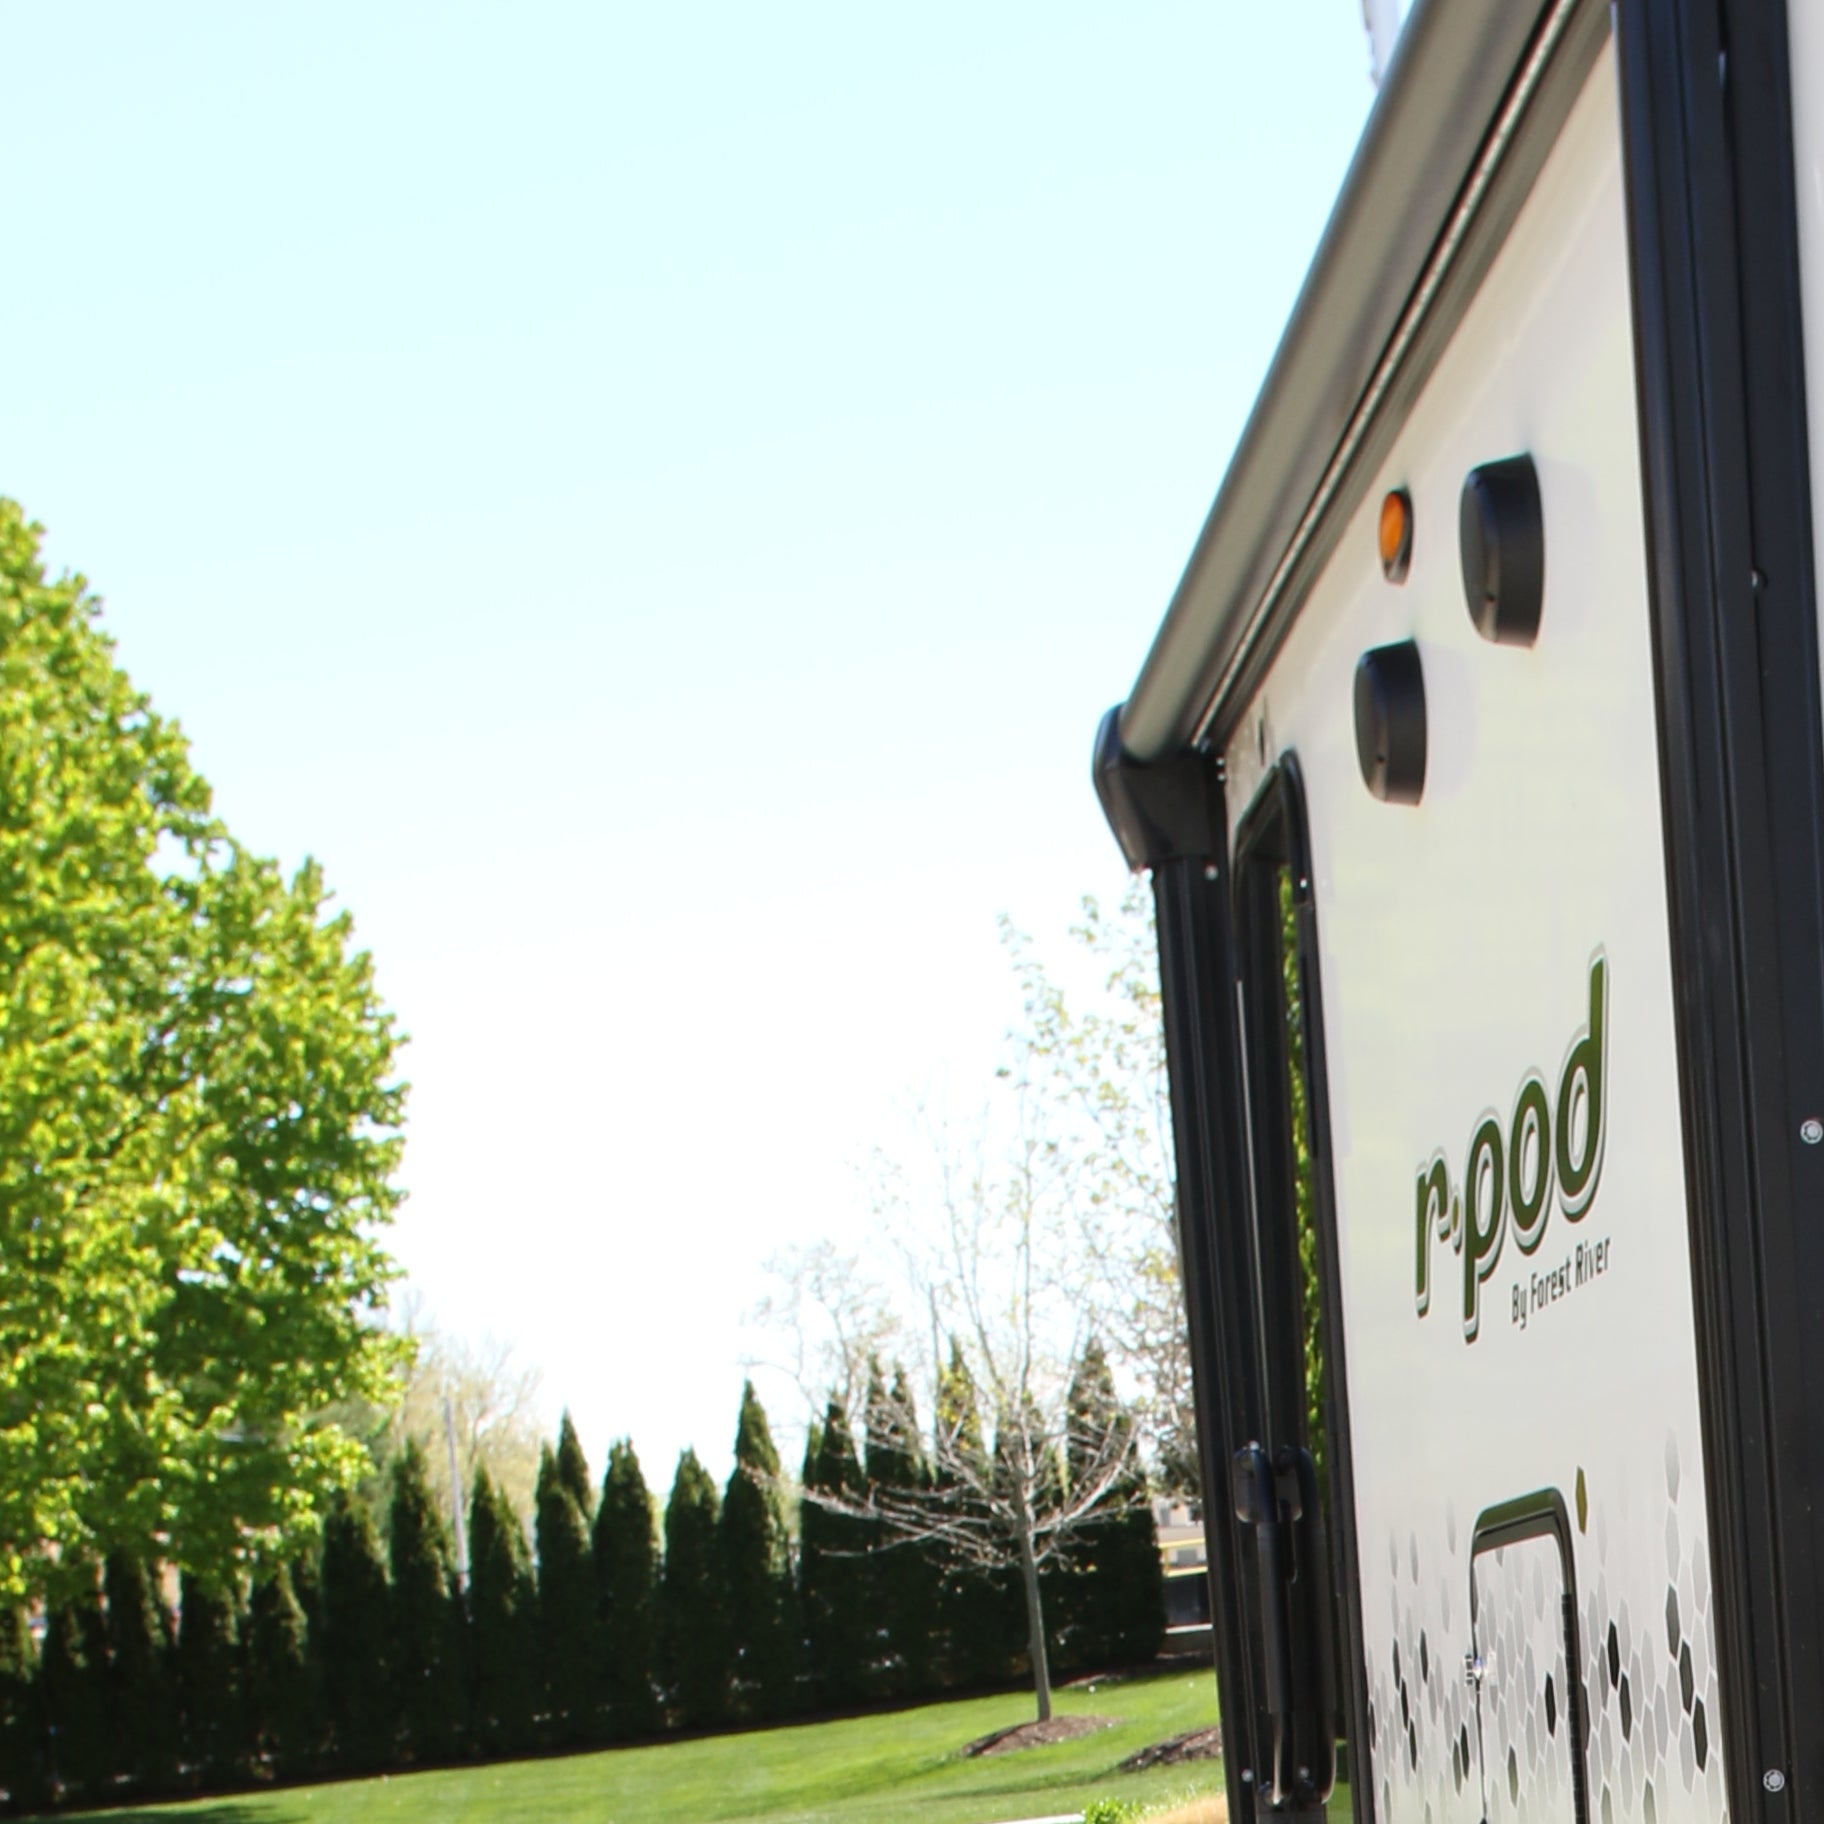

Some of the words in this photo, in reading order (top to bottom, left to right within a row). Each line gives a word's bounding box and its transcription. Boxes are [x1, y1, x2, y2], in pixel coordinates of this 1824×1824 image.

[1512, 1282, 1527, 1331] By
[1530, 1271, 1571, 1314] Forest
[1575, 1236, 1610, 1288] River
